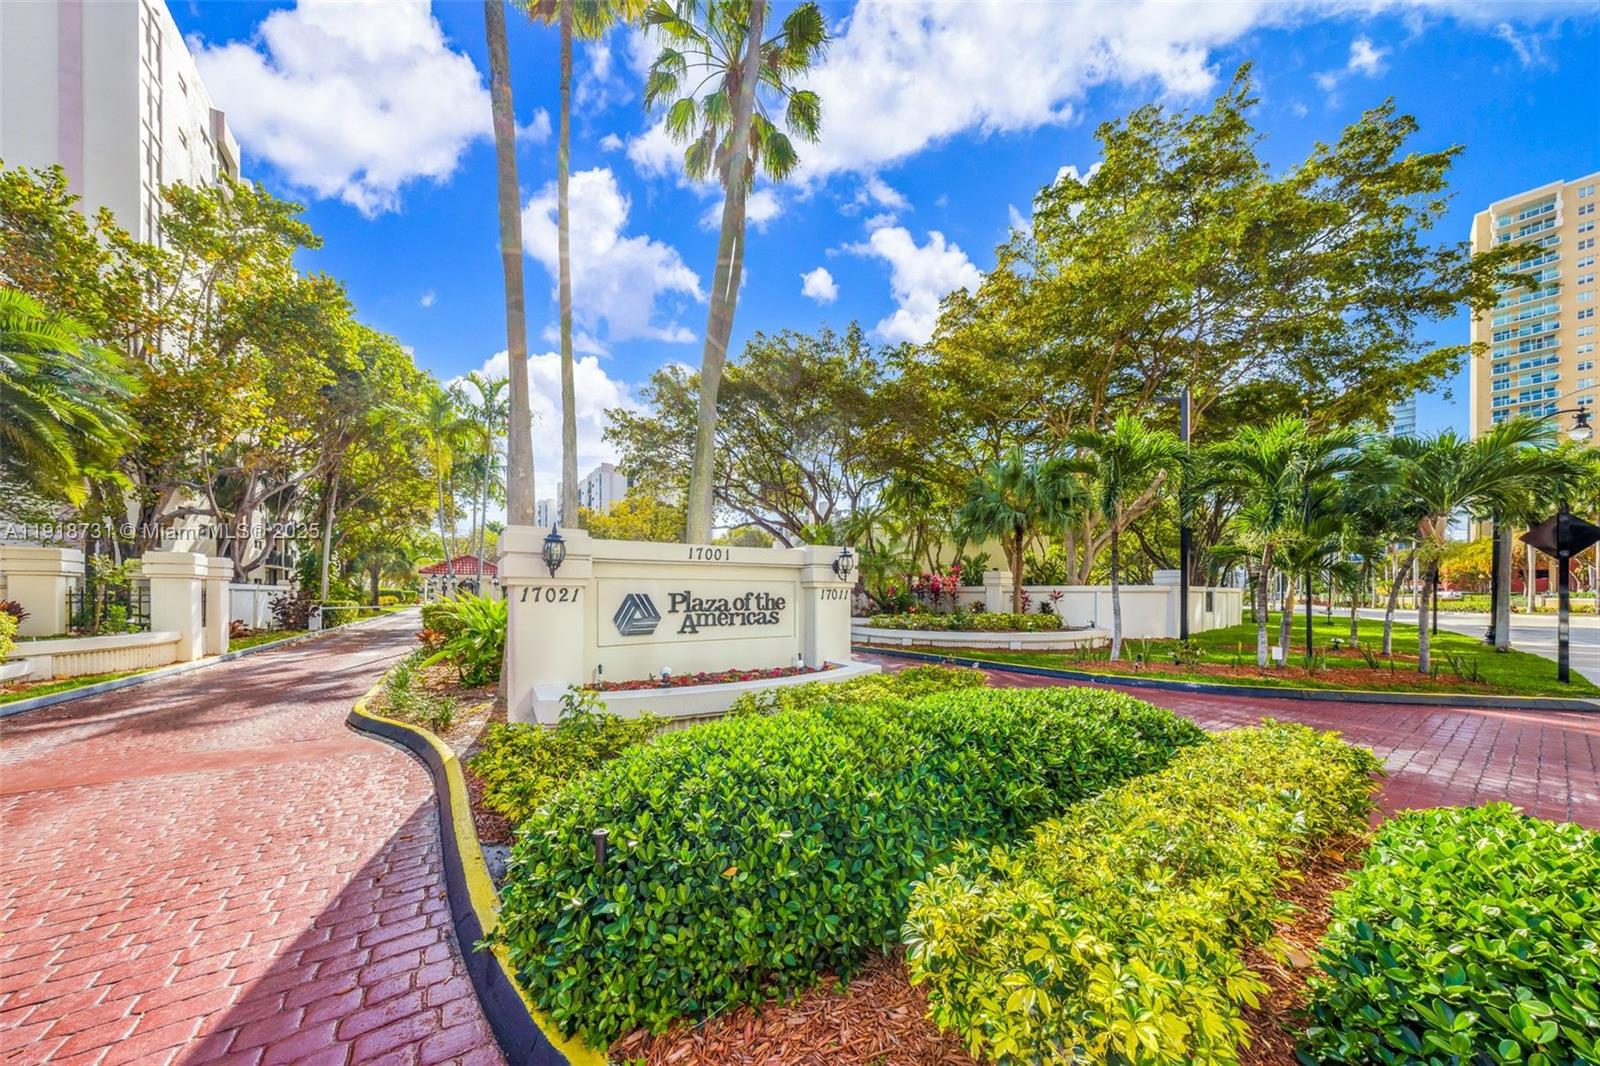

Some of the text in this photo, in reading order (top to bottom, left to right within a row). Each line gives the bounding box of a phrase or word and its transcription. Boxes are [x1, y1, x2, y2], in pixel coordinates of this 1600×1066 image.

[688, 546, 730, 561] 17001
[520, 587, 580, 603] 17021
[668, 590, 786, 613] Plaza of the
[820, 588, 849, 600] 17011
[677, 610, 780, 634] Americas
